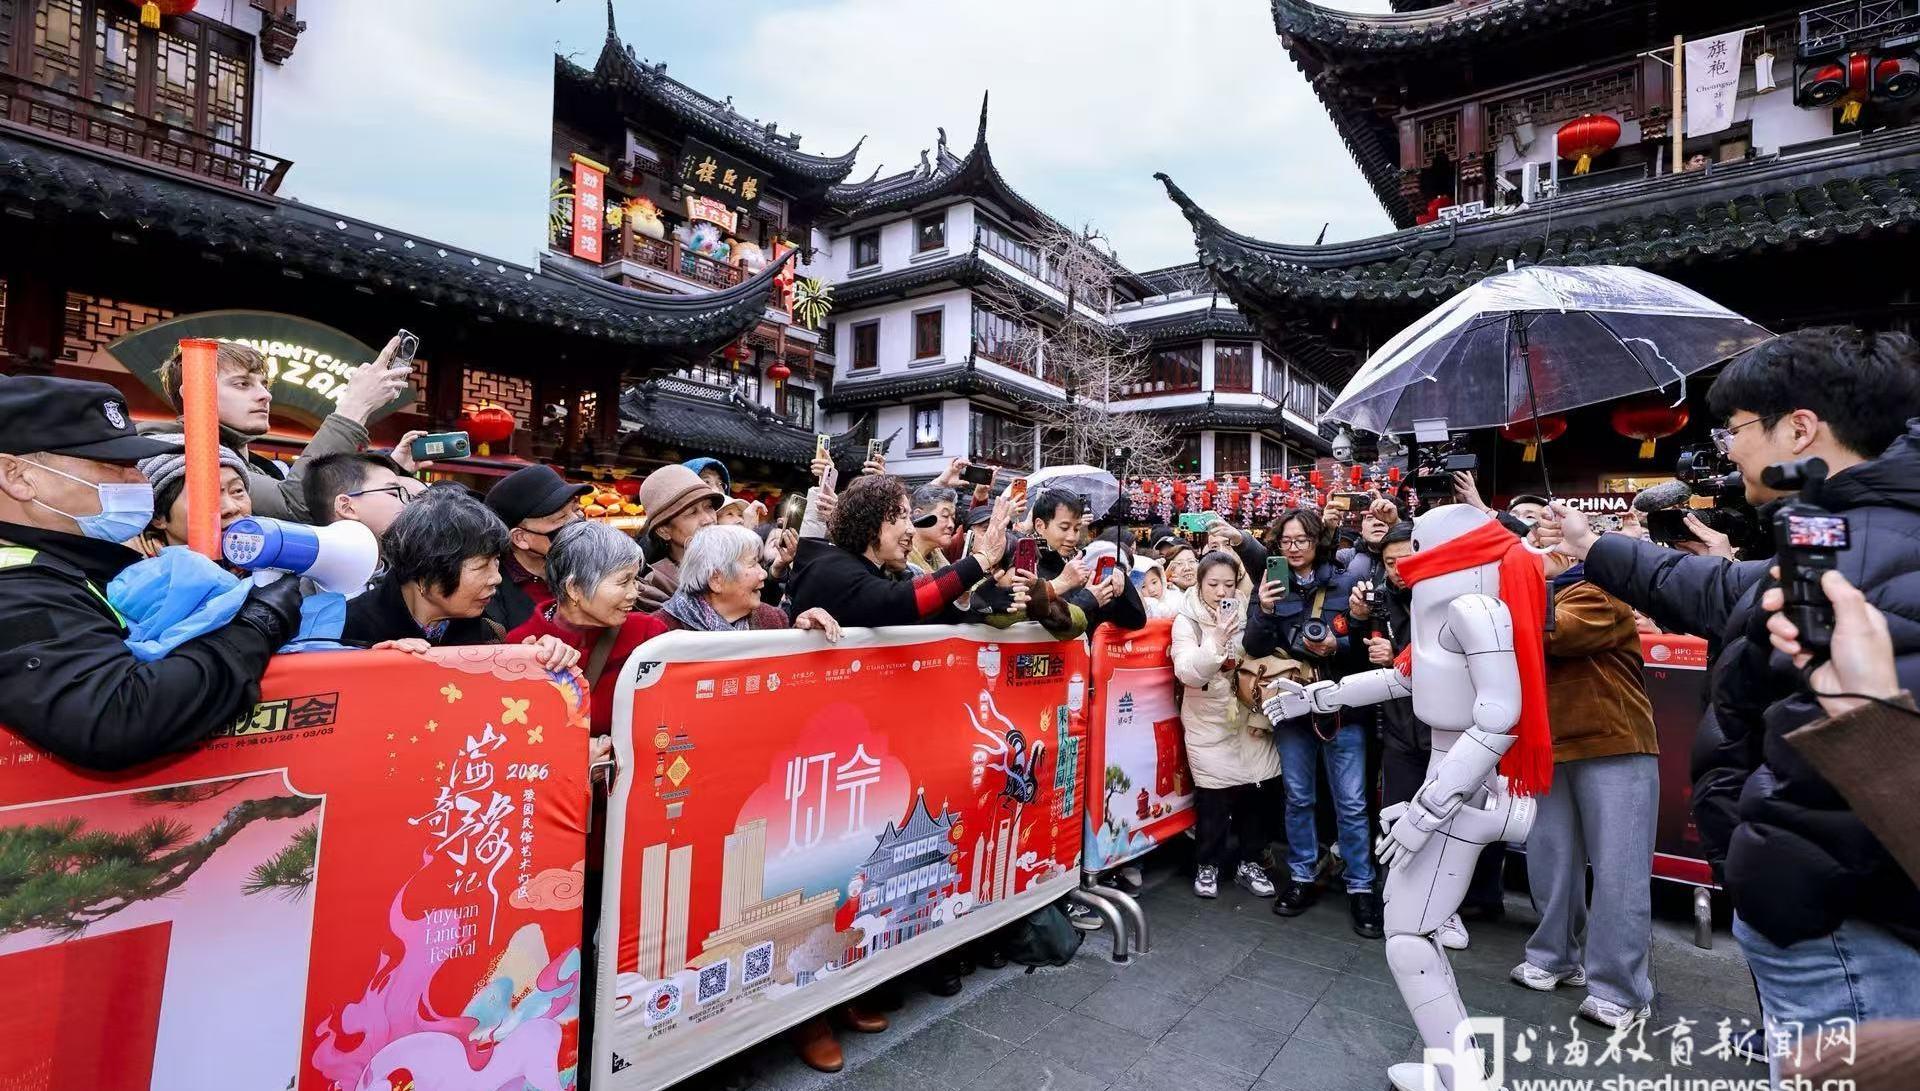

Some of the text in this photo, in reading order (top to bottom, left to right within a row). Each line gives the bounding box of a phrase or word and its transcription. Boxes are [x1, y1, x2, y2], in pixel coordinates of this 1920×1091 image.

[1707, 40, 1729, 78] 旗袍
[1674, 648, 1692, 656] BFC
[506, 763, 550, 780] 2026
[783, 743, 881, 853] 灯会
[517, 788, 535, 900] 豫园民俗艺术灯区
[423, 902, 479, 926] Yuyuan
[424, 922, 477, 945] Lantern
[430, 941, 476, 964] Festival
